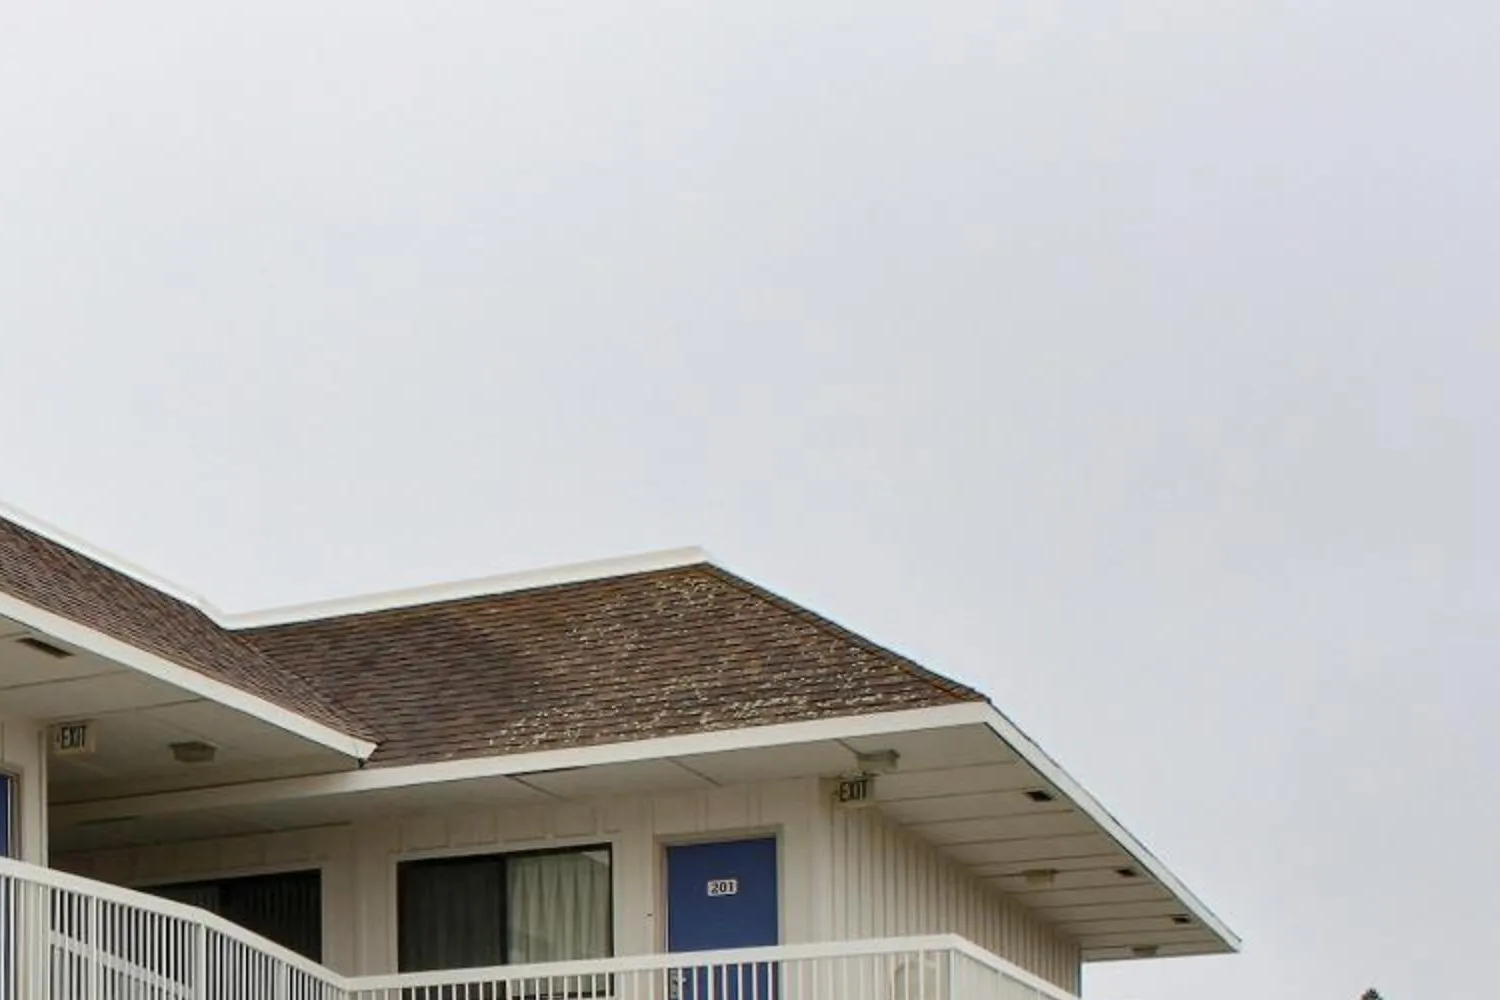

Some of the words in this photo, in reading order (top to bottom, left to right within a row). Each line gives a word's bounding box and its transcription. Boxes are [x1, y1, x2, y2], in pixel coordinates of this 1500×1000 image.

[61, 725, 86, 750] EXIT
[839, 779, 867, 803] EXIT
[711, 881, 734, 895] 201
